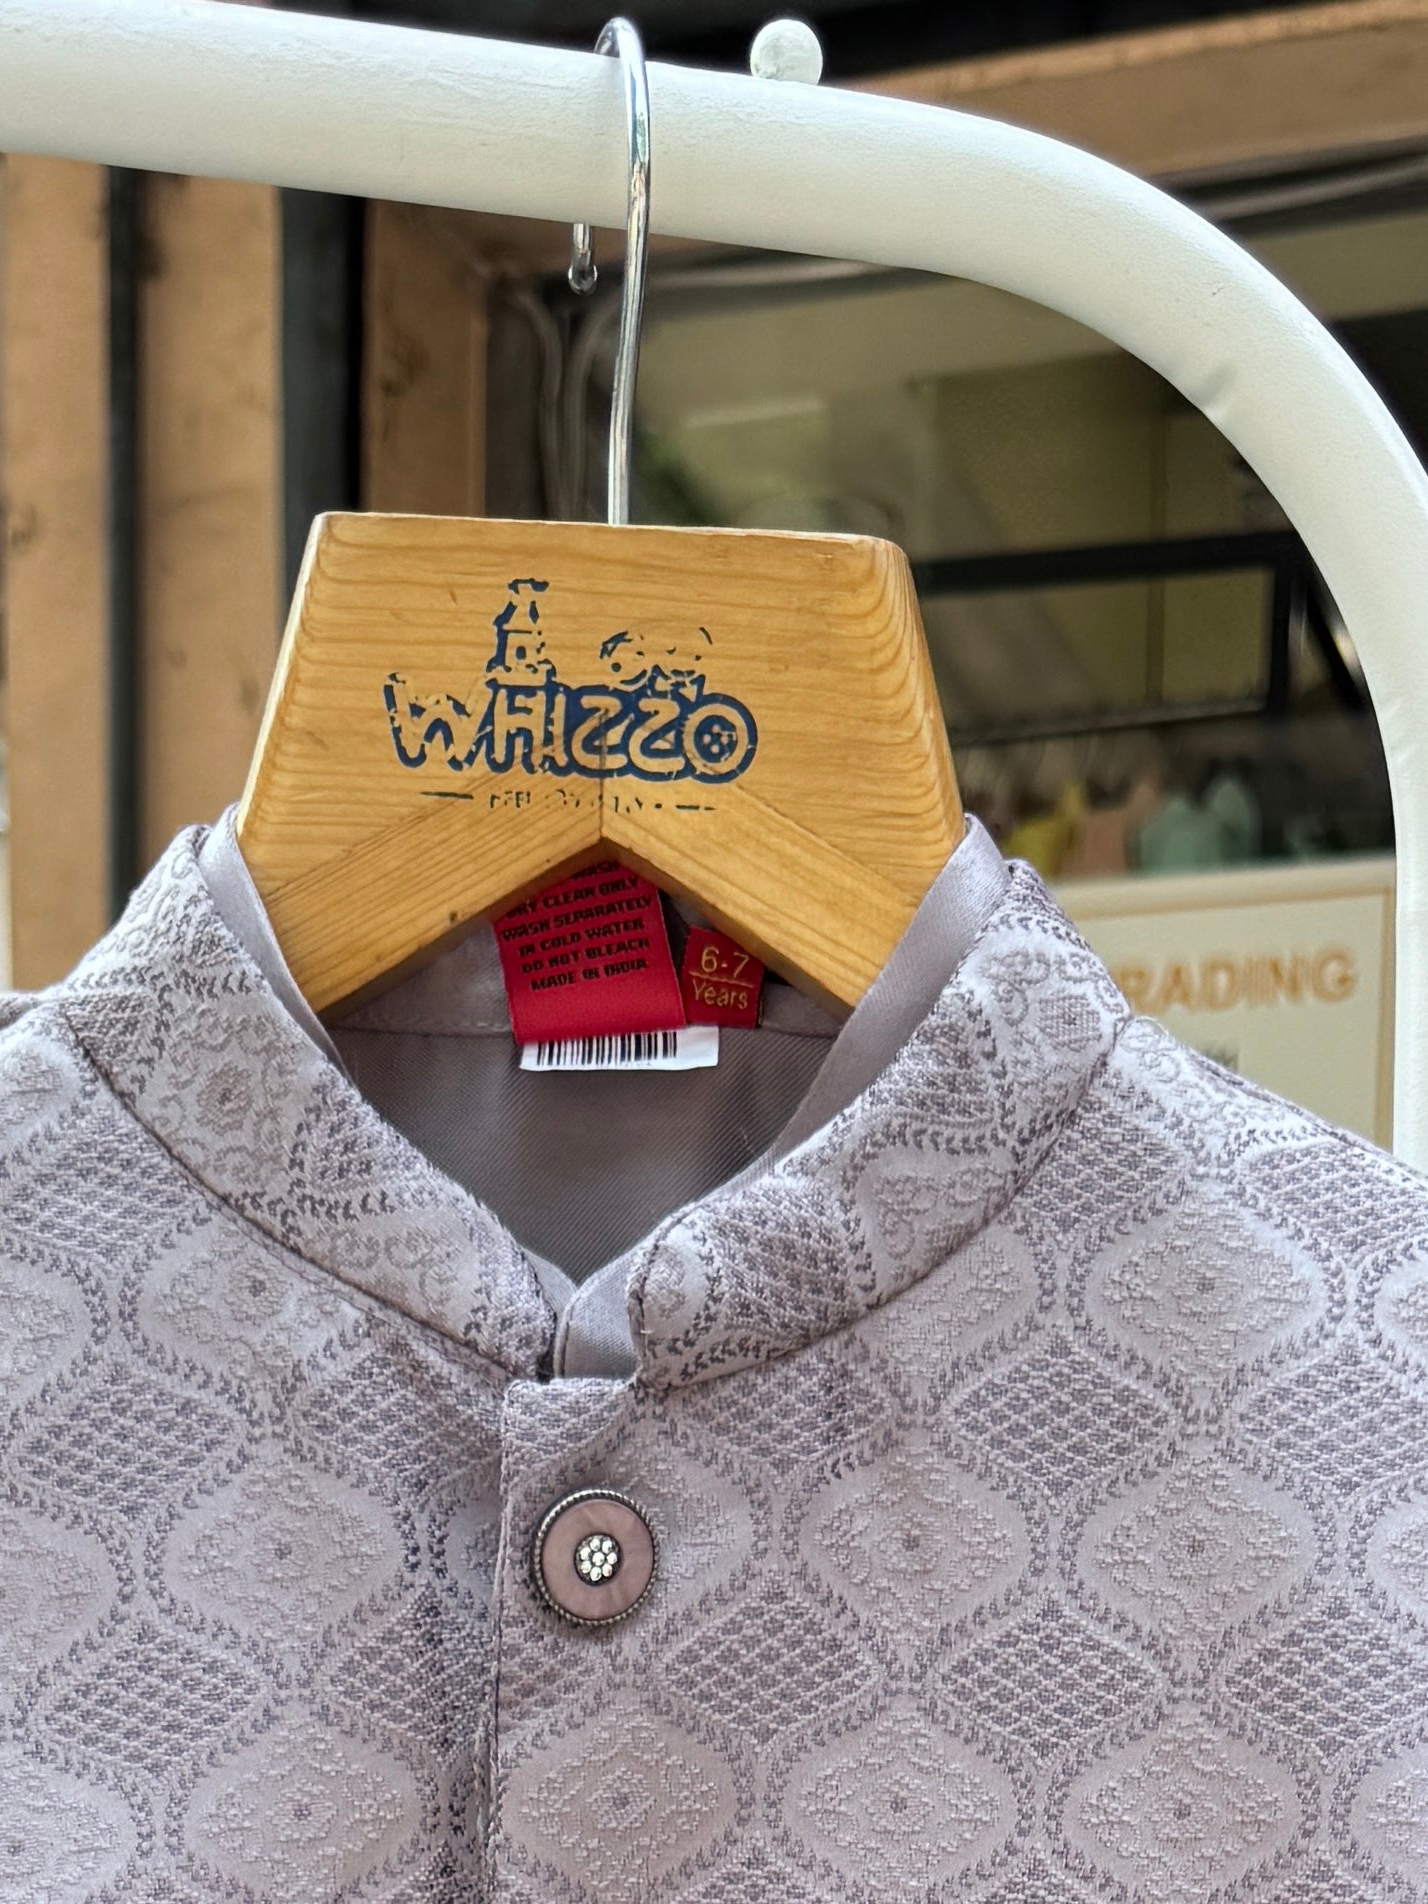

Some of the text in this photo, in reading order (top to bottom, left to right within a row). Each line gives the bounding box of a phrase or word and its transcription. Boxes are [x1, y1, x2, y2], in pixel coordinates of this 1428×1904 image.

[383, 671, 759, 785] WHIZZO
[543, 886, 596, 909] CLEAN
[599, 876, 639, 897] ONLY
[501, 896, 653, 941] WASH SEPARATELY
[518, 918, 645, 958] IN COLD WATER
[521, 938, 650, 974] DO NOT BLEACH
[531, 957, 648, 991] MADE IN INDIA
[700, 945, 750, 978] 6-7
[691, 979, 749, 1010] Years
[1112, 945, 1357, 1015] RADING
